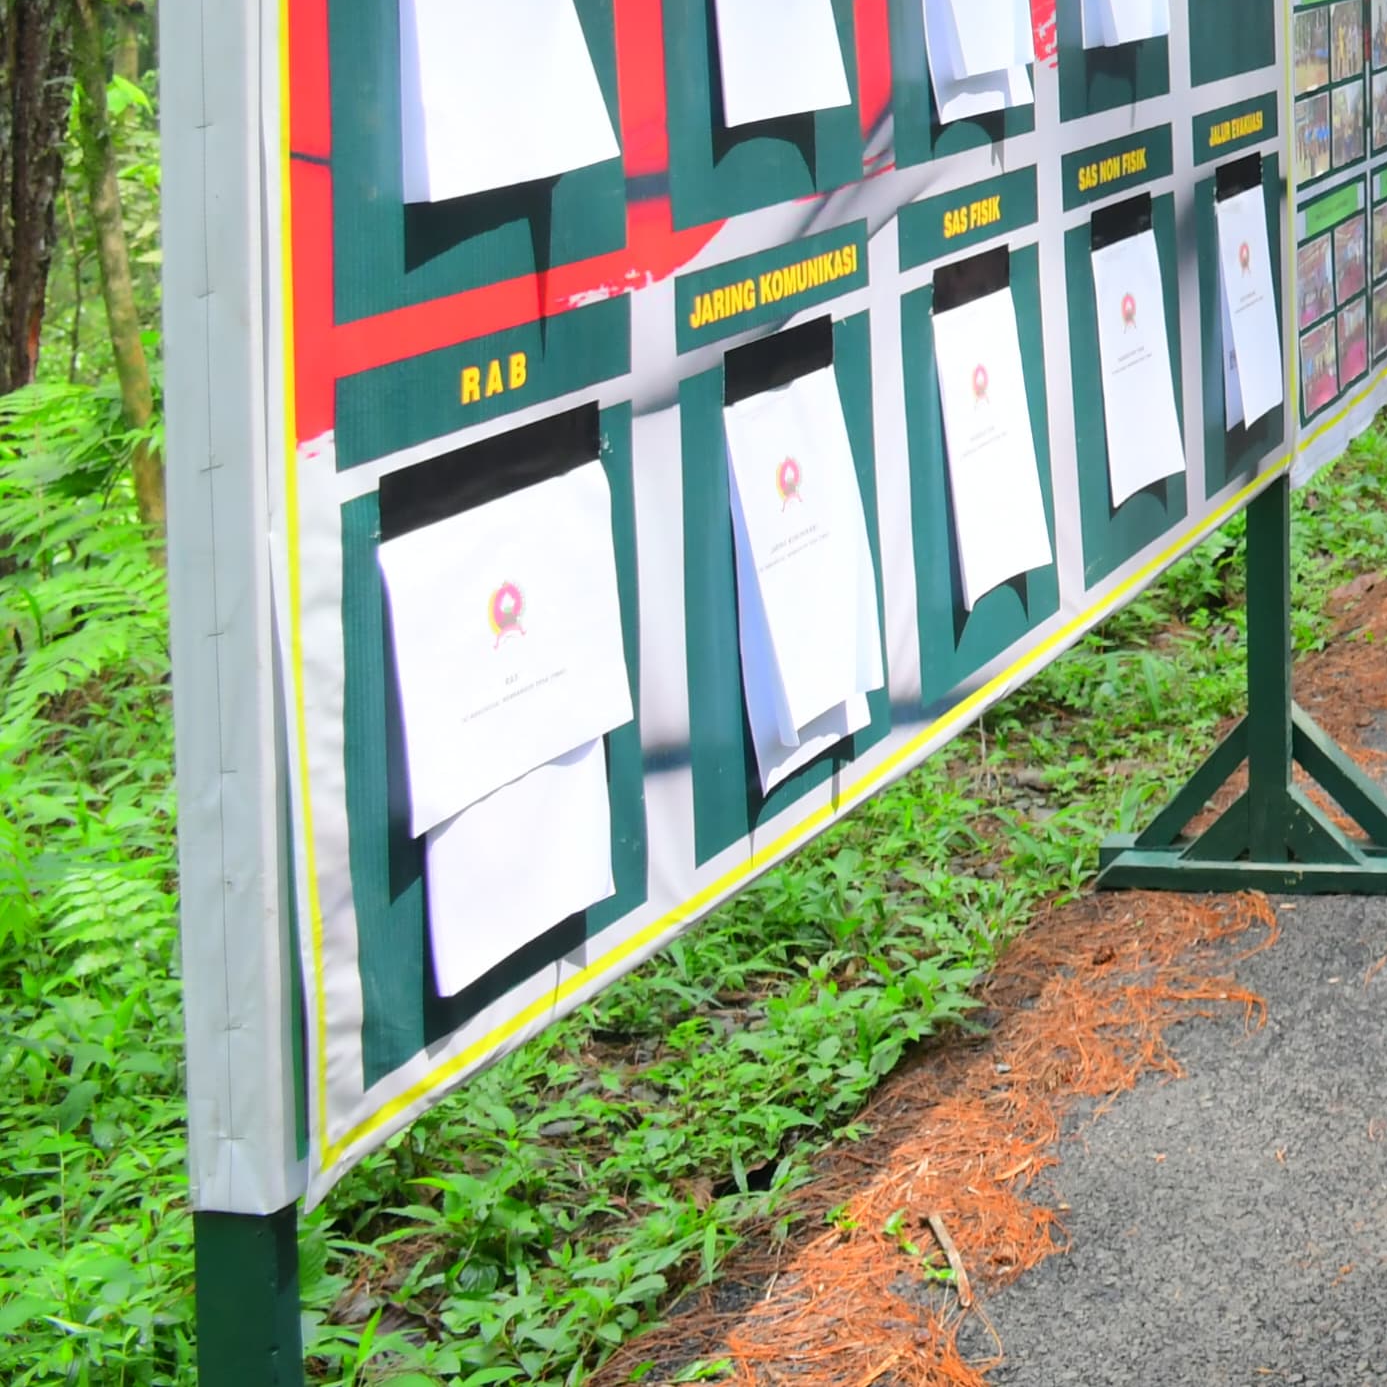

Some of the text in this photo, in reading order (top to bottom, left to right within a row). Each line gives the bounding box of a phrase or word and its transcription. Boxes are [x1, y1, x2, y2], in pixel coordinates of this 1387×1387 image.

[1078, 147, 1147, 191] SAS NON FISIK
[943, 195, 1001, 238] SAS FISIK
[689, 244, 857, 329] JARING KOMUNIKASI
